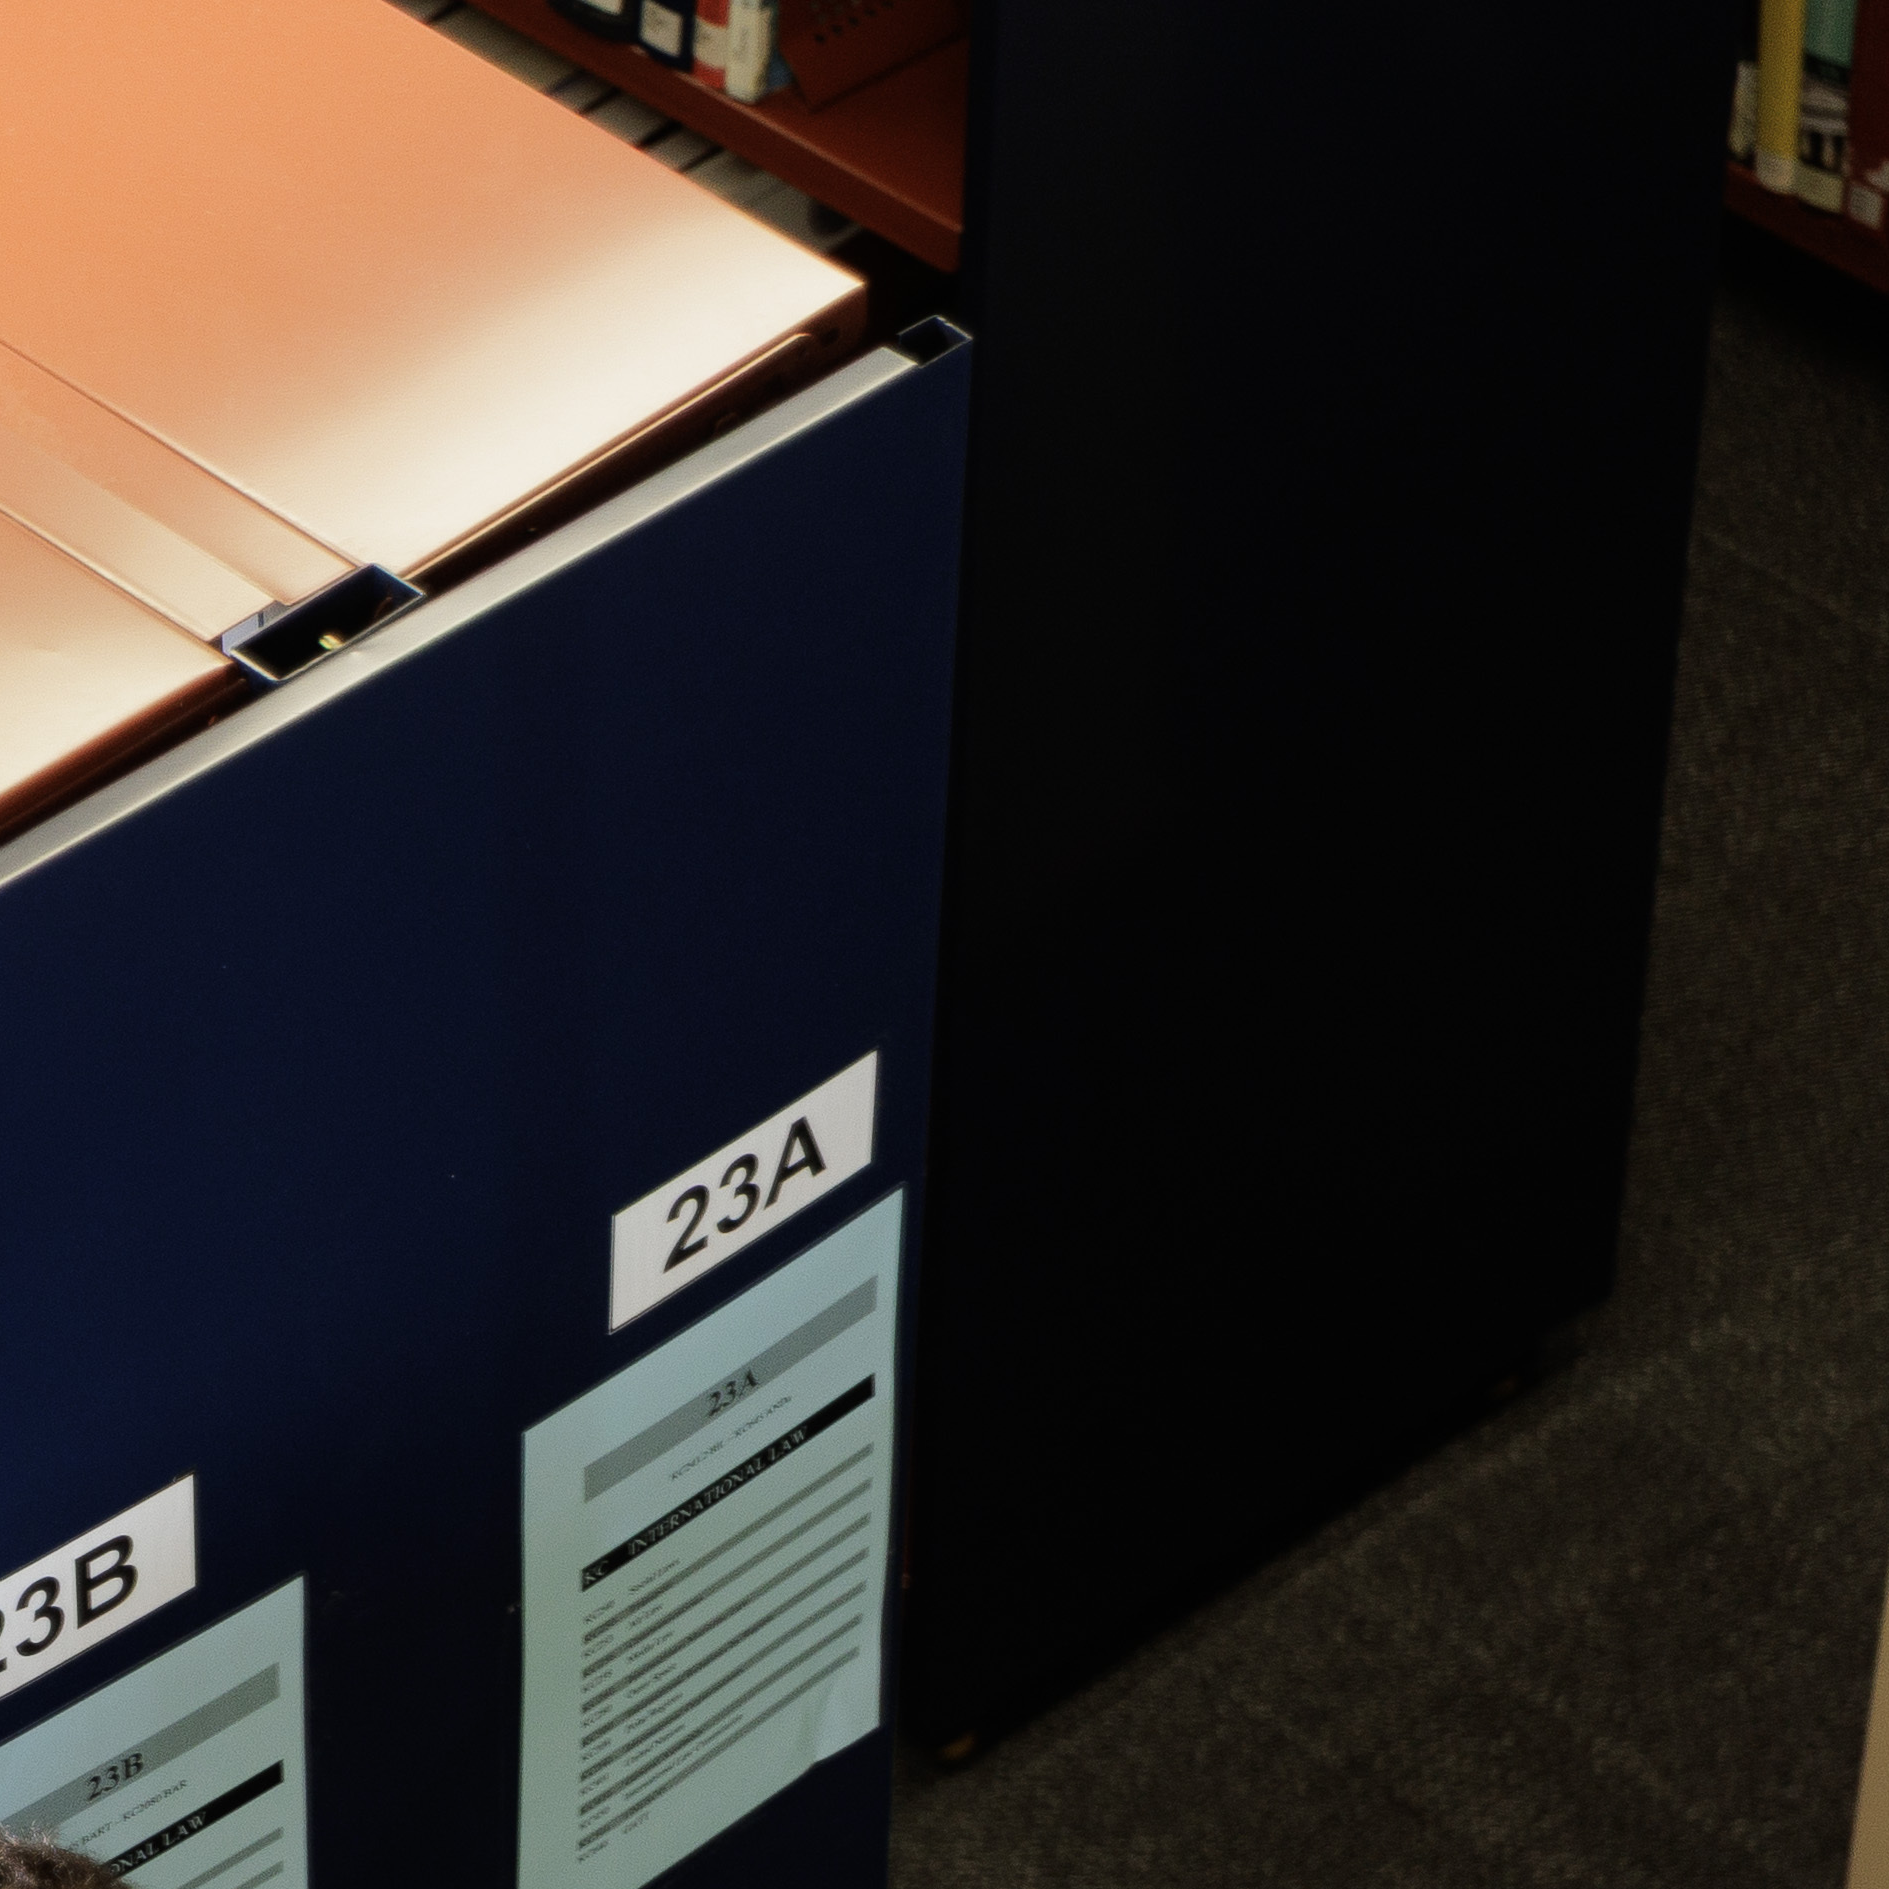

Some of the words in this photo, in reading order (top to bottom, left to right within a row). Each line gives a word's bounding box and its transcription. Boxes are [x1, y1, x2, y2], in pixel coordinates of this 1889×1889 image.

[663, 1115, 828, 1274] 23A
[706, 1367, 761, 1418] 23A
[627, 1454, 763, 1559] INTERNATIONAL
[767, 1425, 807, 1465] LAW
[86, 1752, 145, 1801] 23B
[161, 1809, 206, 1849] LAW
